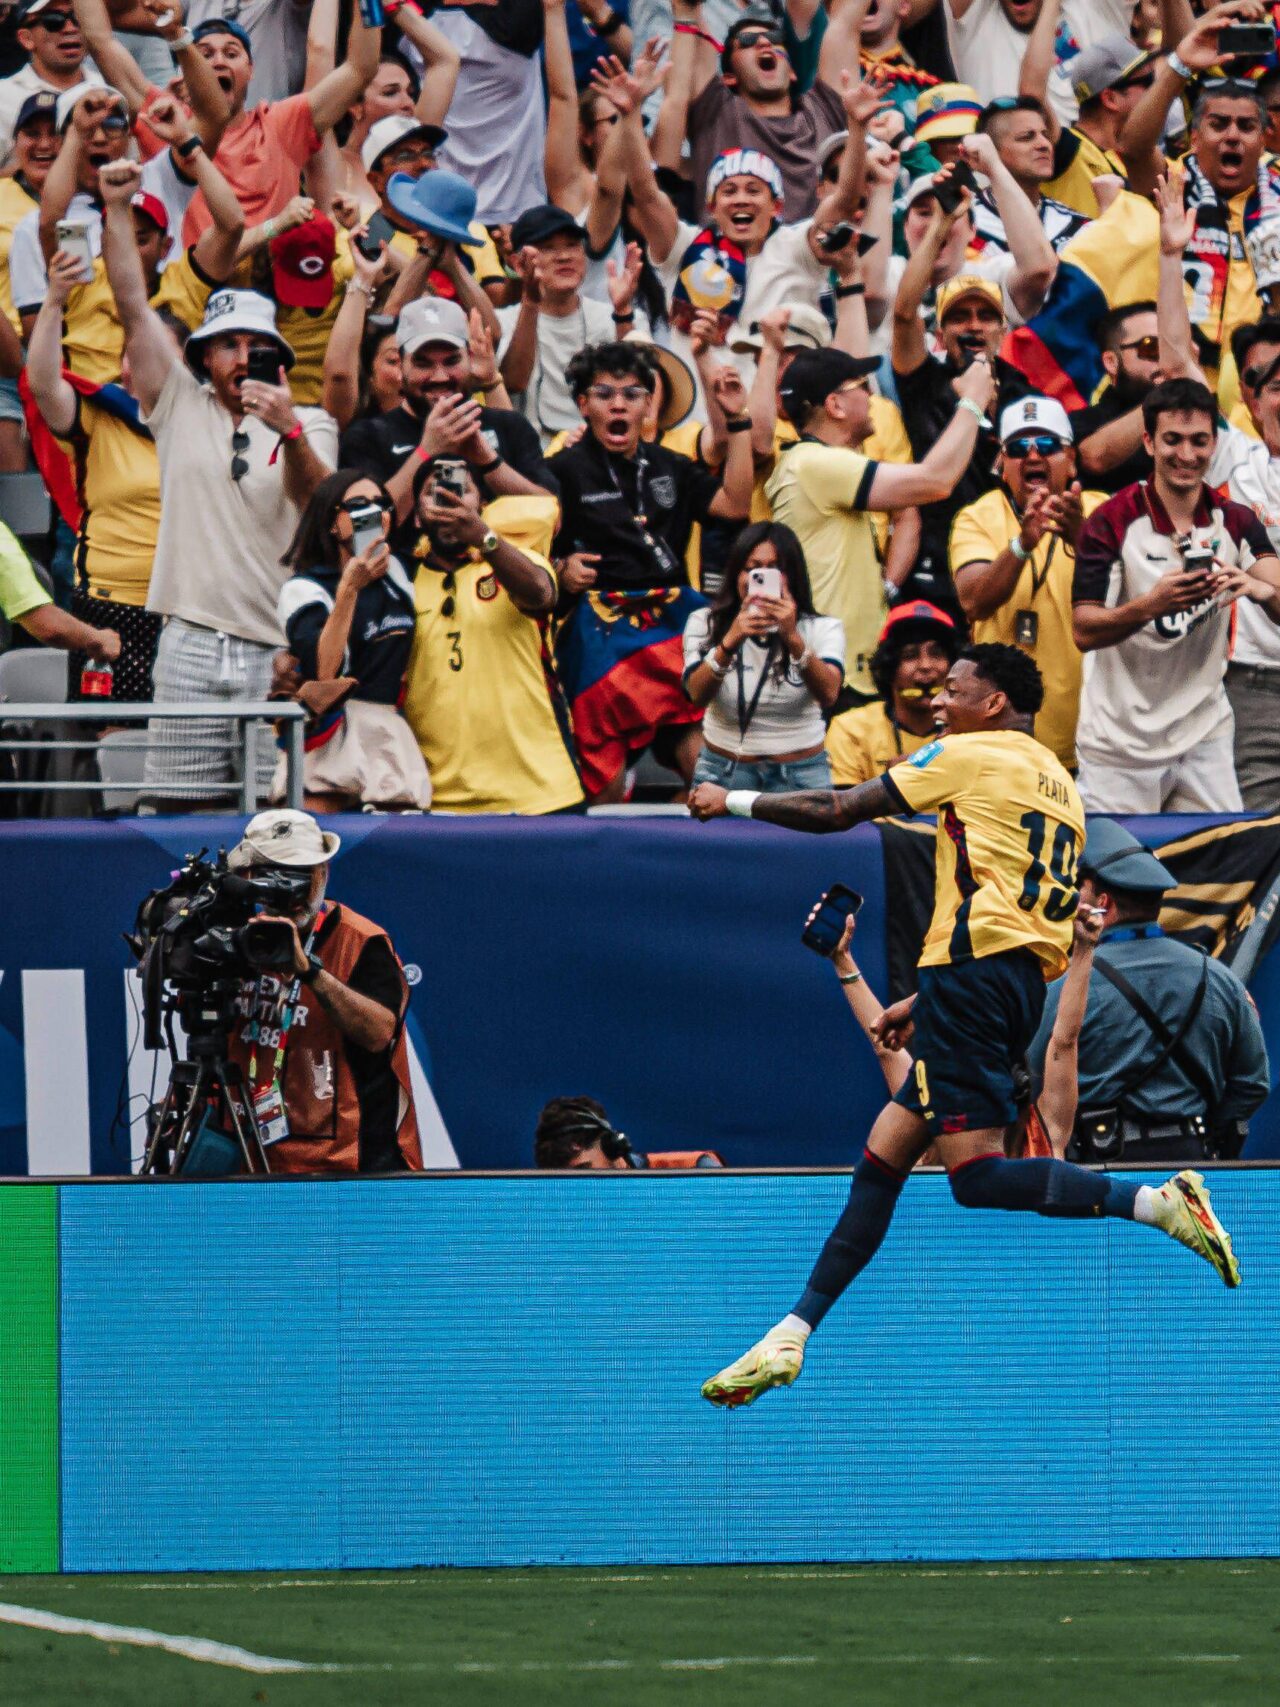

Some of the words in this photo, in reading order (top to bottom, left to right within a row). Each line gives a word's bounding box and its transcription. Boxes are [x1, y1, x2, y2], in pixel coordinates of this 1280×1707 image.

[446, 631, 463, 671] 3
[1037, 771, 1070, 808] PLATA
[1018, 810, 1081, 922] 19
